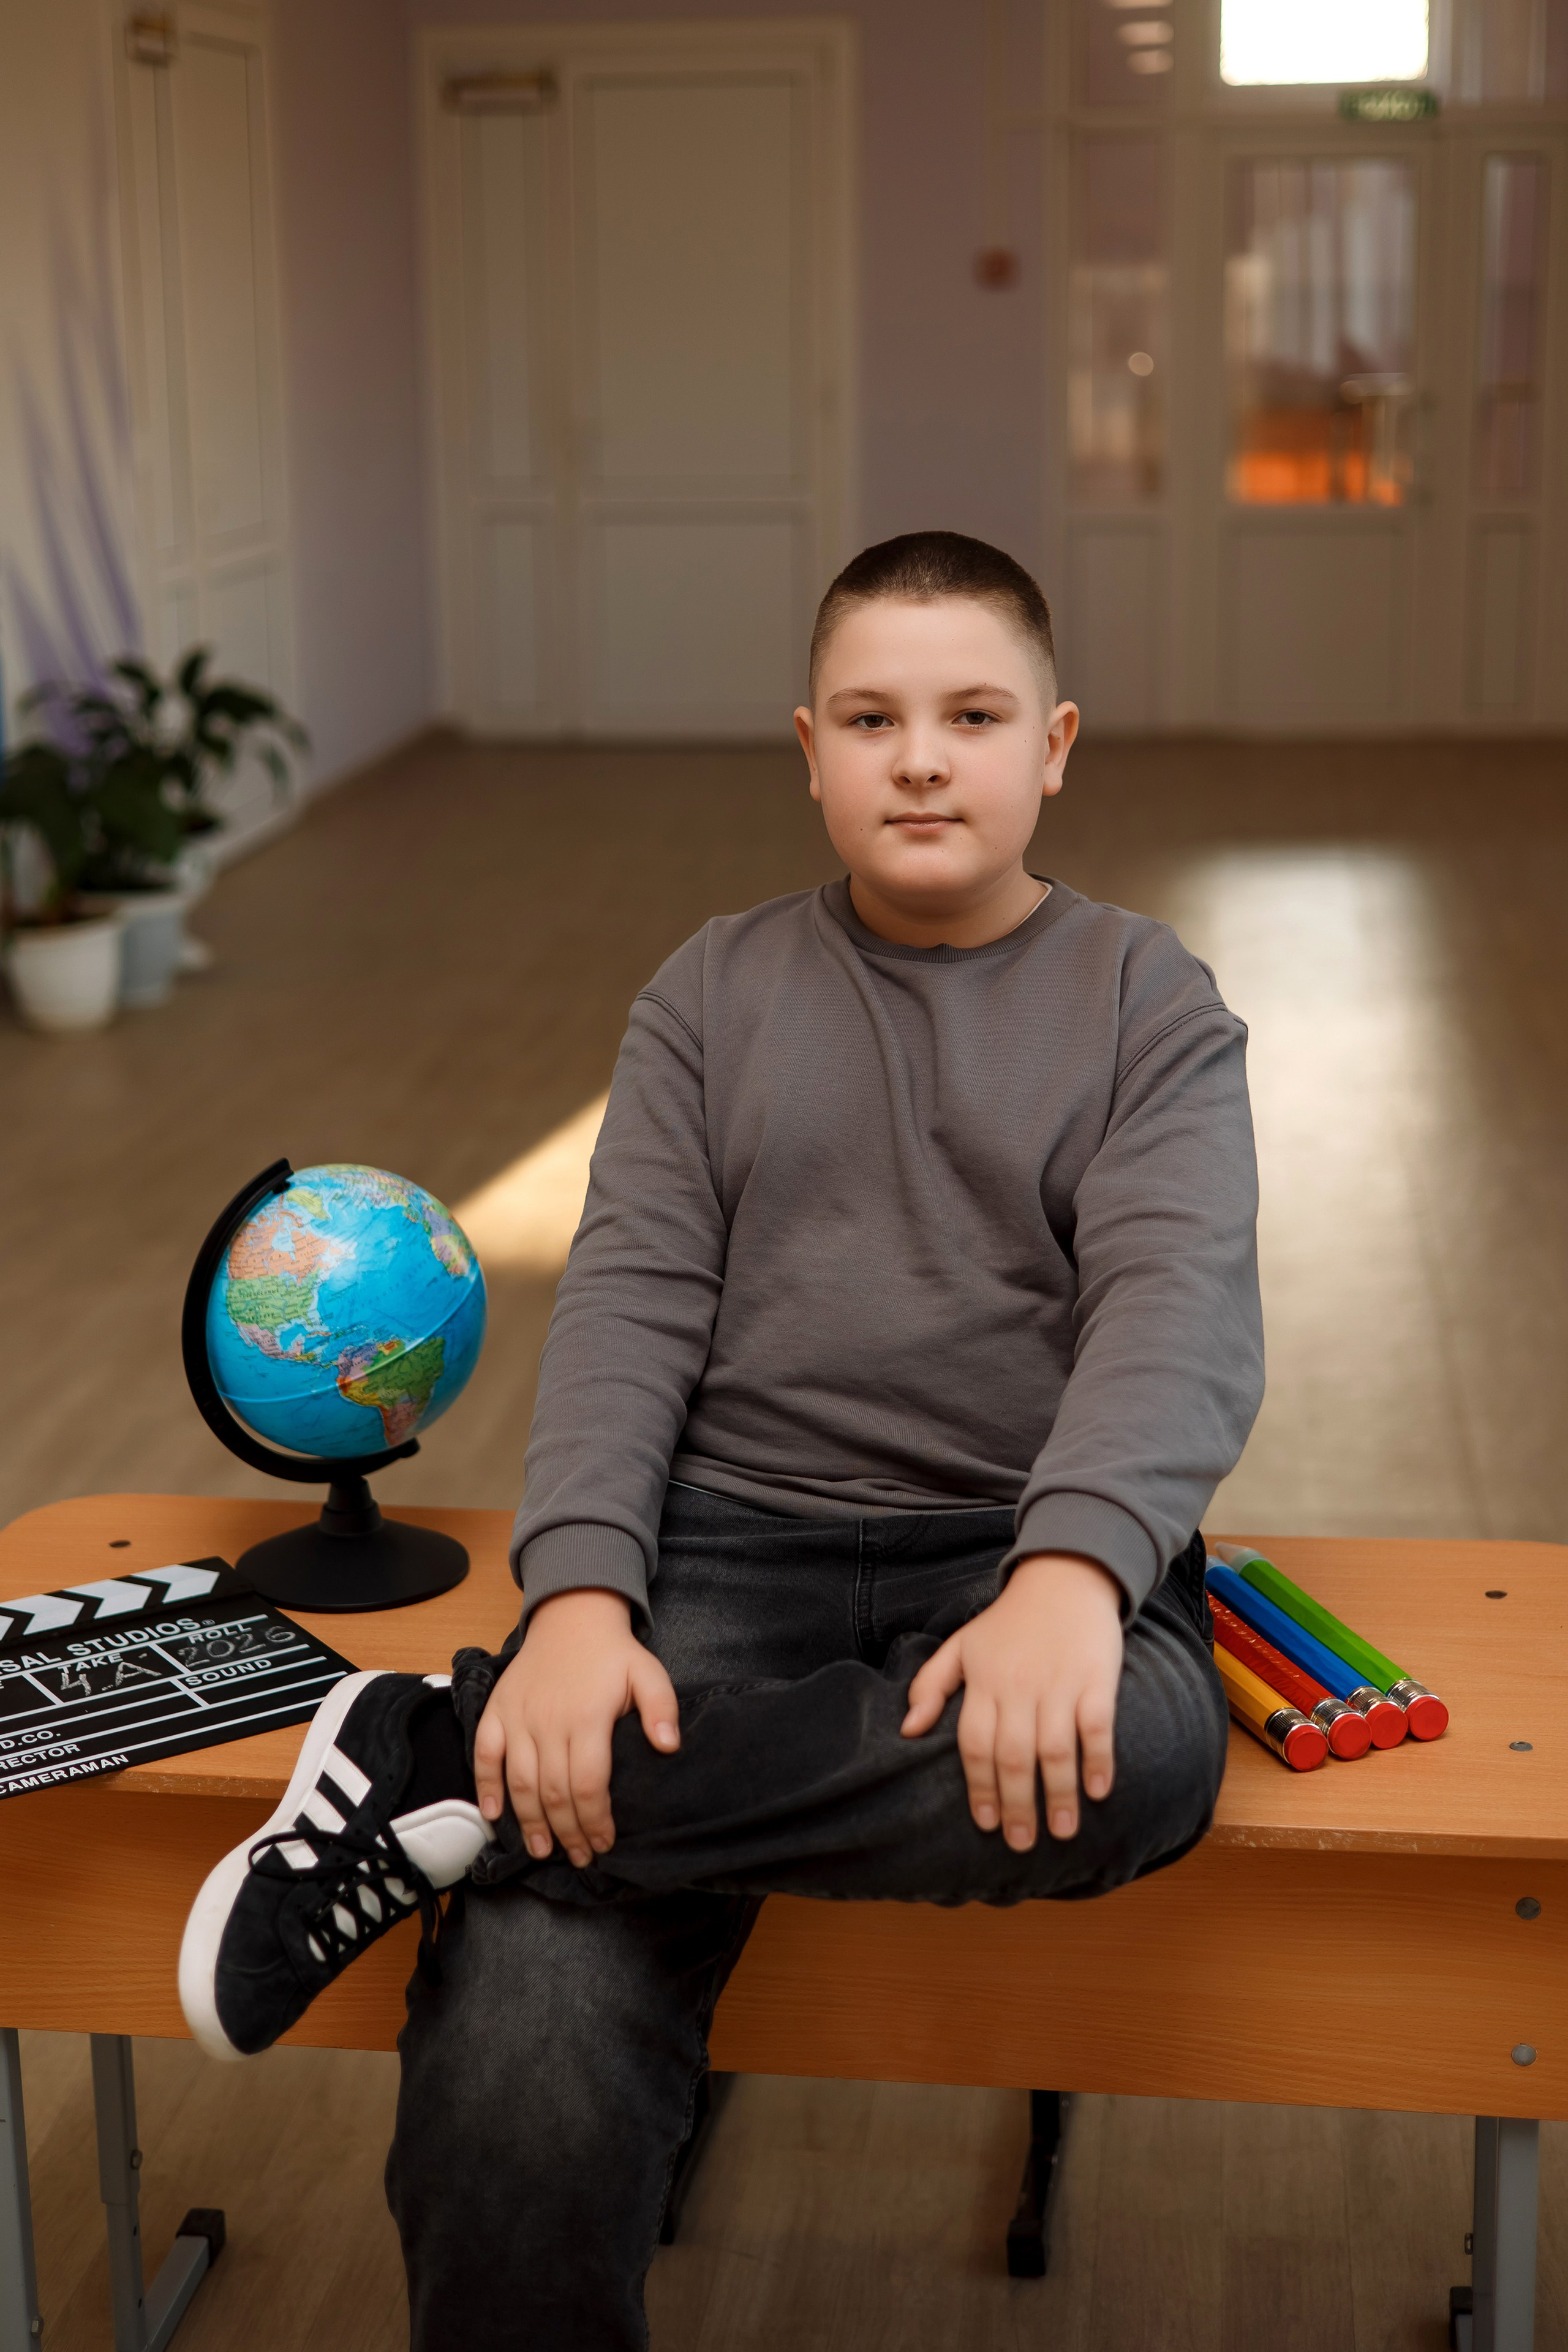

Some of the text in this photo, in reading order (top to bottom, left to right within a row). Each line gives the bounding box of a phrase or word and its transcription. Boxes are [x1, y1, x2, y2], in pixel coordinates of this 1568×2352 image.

[187, 1623, 252, 1644] ROLL
[178, 1626, 296, 1667] 2026
[0, 1652, 62, 1674] SAL
[58, 1653, 123, 1674] TAKE
[185, 1659, 272, 1686] SOUND
